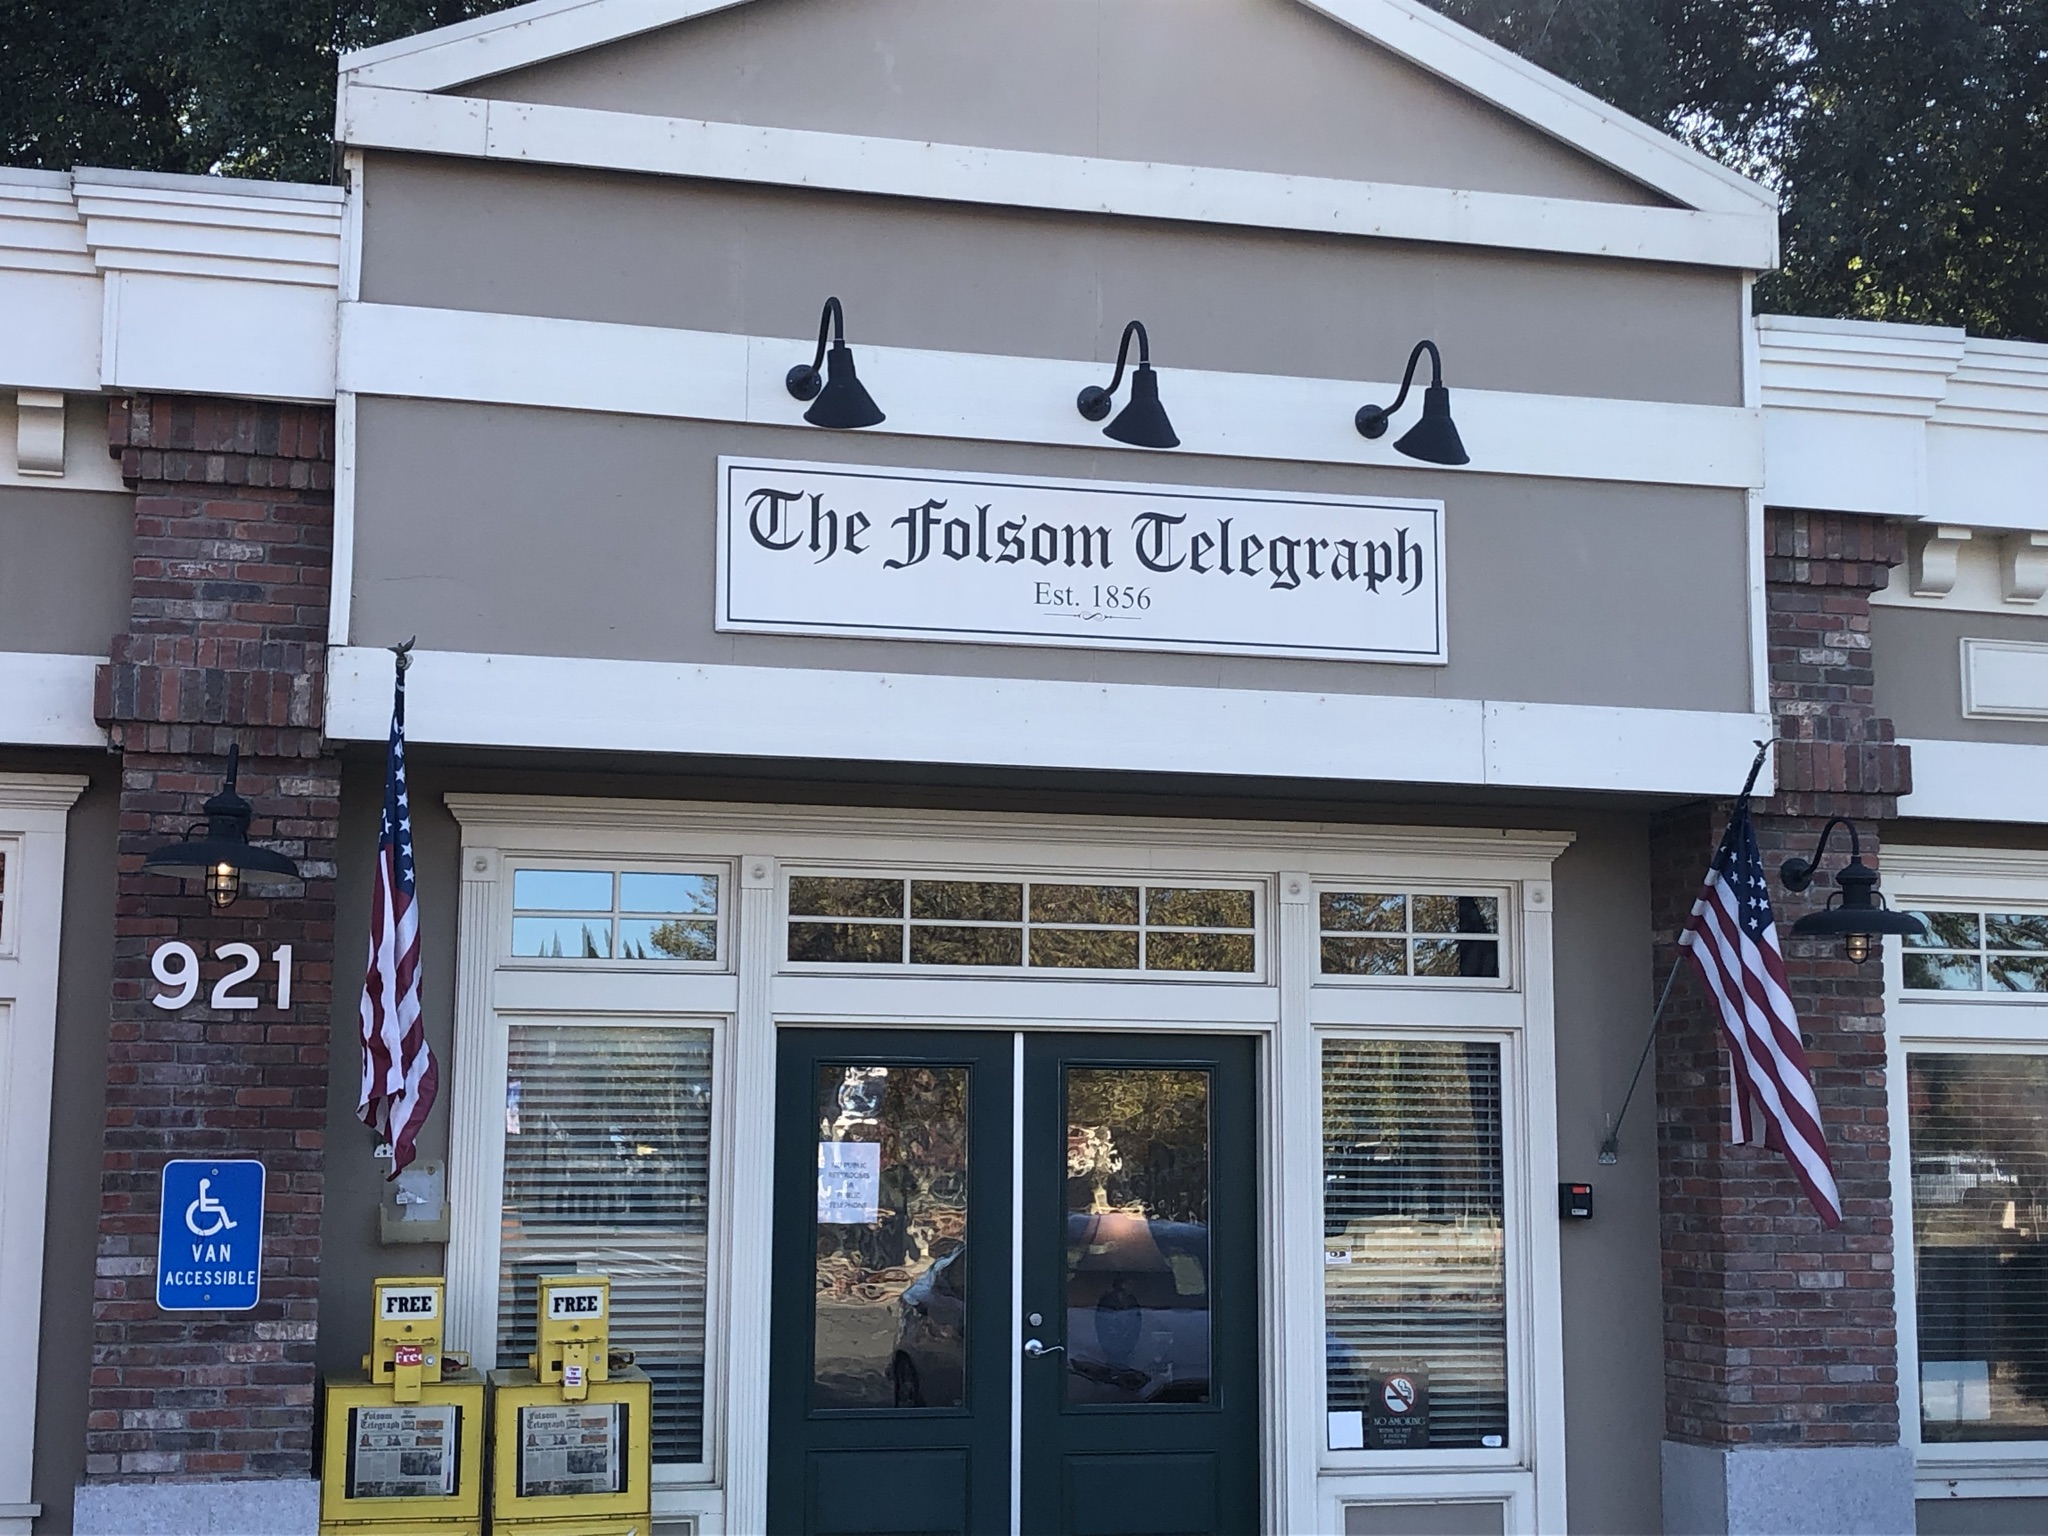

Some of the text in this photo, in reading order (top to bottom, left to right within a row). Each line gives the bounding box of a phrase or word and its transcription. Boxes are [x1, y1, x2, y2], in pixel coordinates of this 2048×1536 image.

[745, 488, 1424, 596] The Folsom Telegraph
[1033, 581, 1152, 611] Est. 1856
[151, 941, 292, 1010] 921
[837, 1191, 861, 1199] PBLIC
[192, 1244, 231, 1263] VAN
[165, 1270, 256, 1286] ACCESSIBLE
[386, 1295, 432, 1313] FREE
[553, 1295, 598, 1313] FREE
[362, 1411, 393, 1420] Folsom
[528, 1411, 558, 1420] Folsom
[1373, 1416, 1426, 1426] NO SMOKING
[360, 1419, 400, 1430] Telegraph
